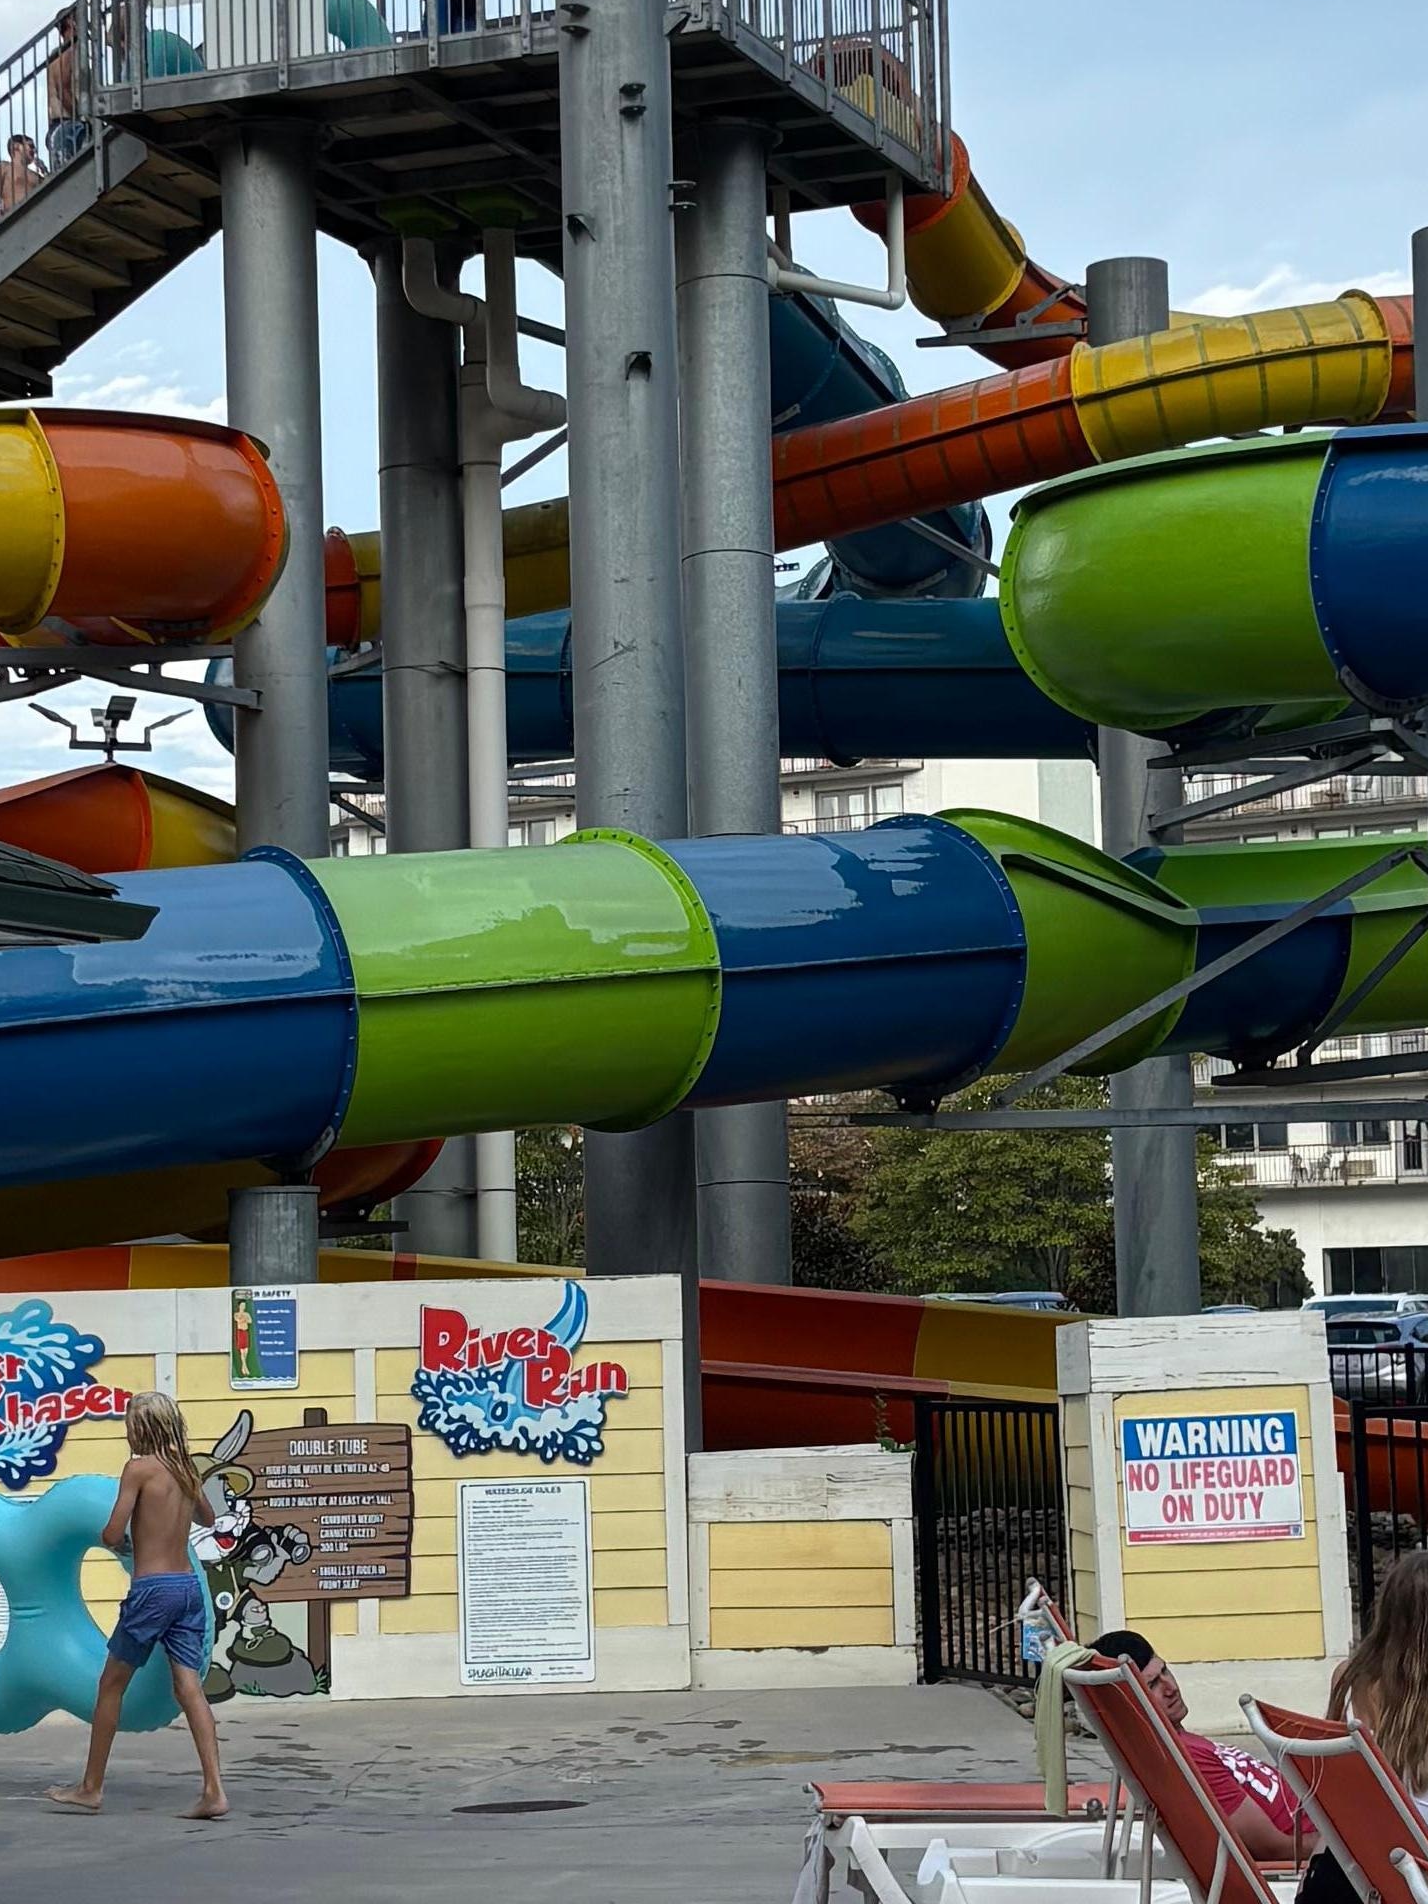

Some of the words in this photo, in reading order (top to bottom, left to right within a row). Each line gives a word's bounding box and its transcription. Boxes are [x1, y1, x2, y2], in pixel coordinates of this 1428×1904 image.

[422, 1306, 558, 1375] River
[524, 1346, 629, 1409] Run
[289, 1439, 335, 1456] DOUBLE
[338, 1439, 368, 1455] TUBE
[1136, 1418, 1285, 1458] WARNING
[266, 1479, 292, 1489] INCHES
[303, 1464, 323, 1474] MUST
[323, 1464, 333, 1473] BE
[334, 1463, 367, 1473] BETWEEN
[1128, 1464, 1160, 1492] NO
[1171, 1458, 1295, 1490] LIFEGUARD
[297, 1497, 317, 1507] MUST
[328, 1496, 338, 1506] AT
[338, 1495, 360, 1506] LEAST
[1161, 1496, 1194, 1523] ON
[1205, 1492, 1264, 1522] DUTY
